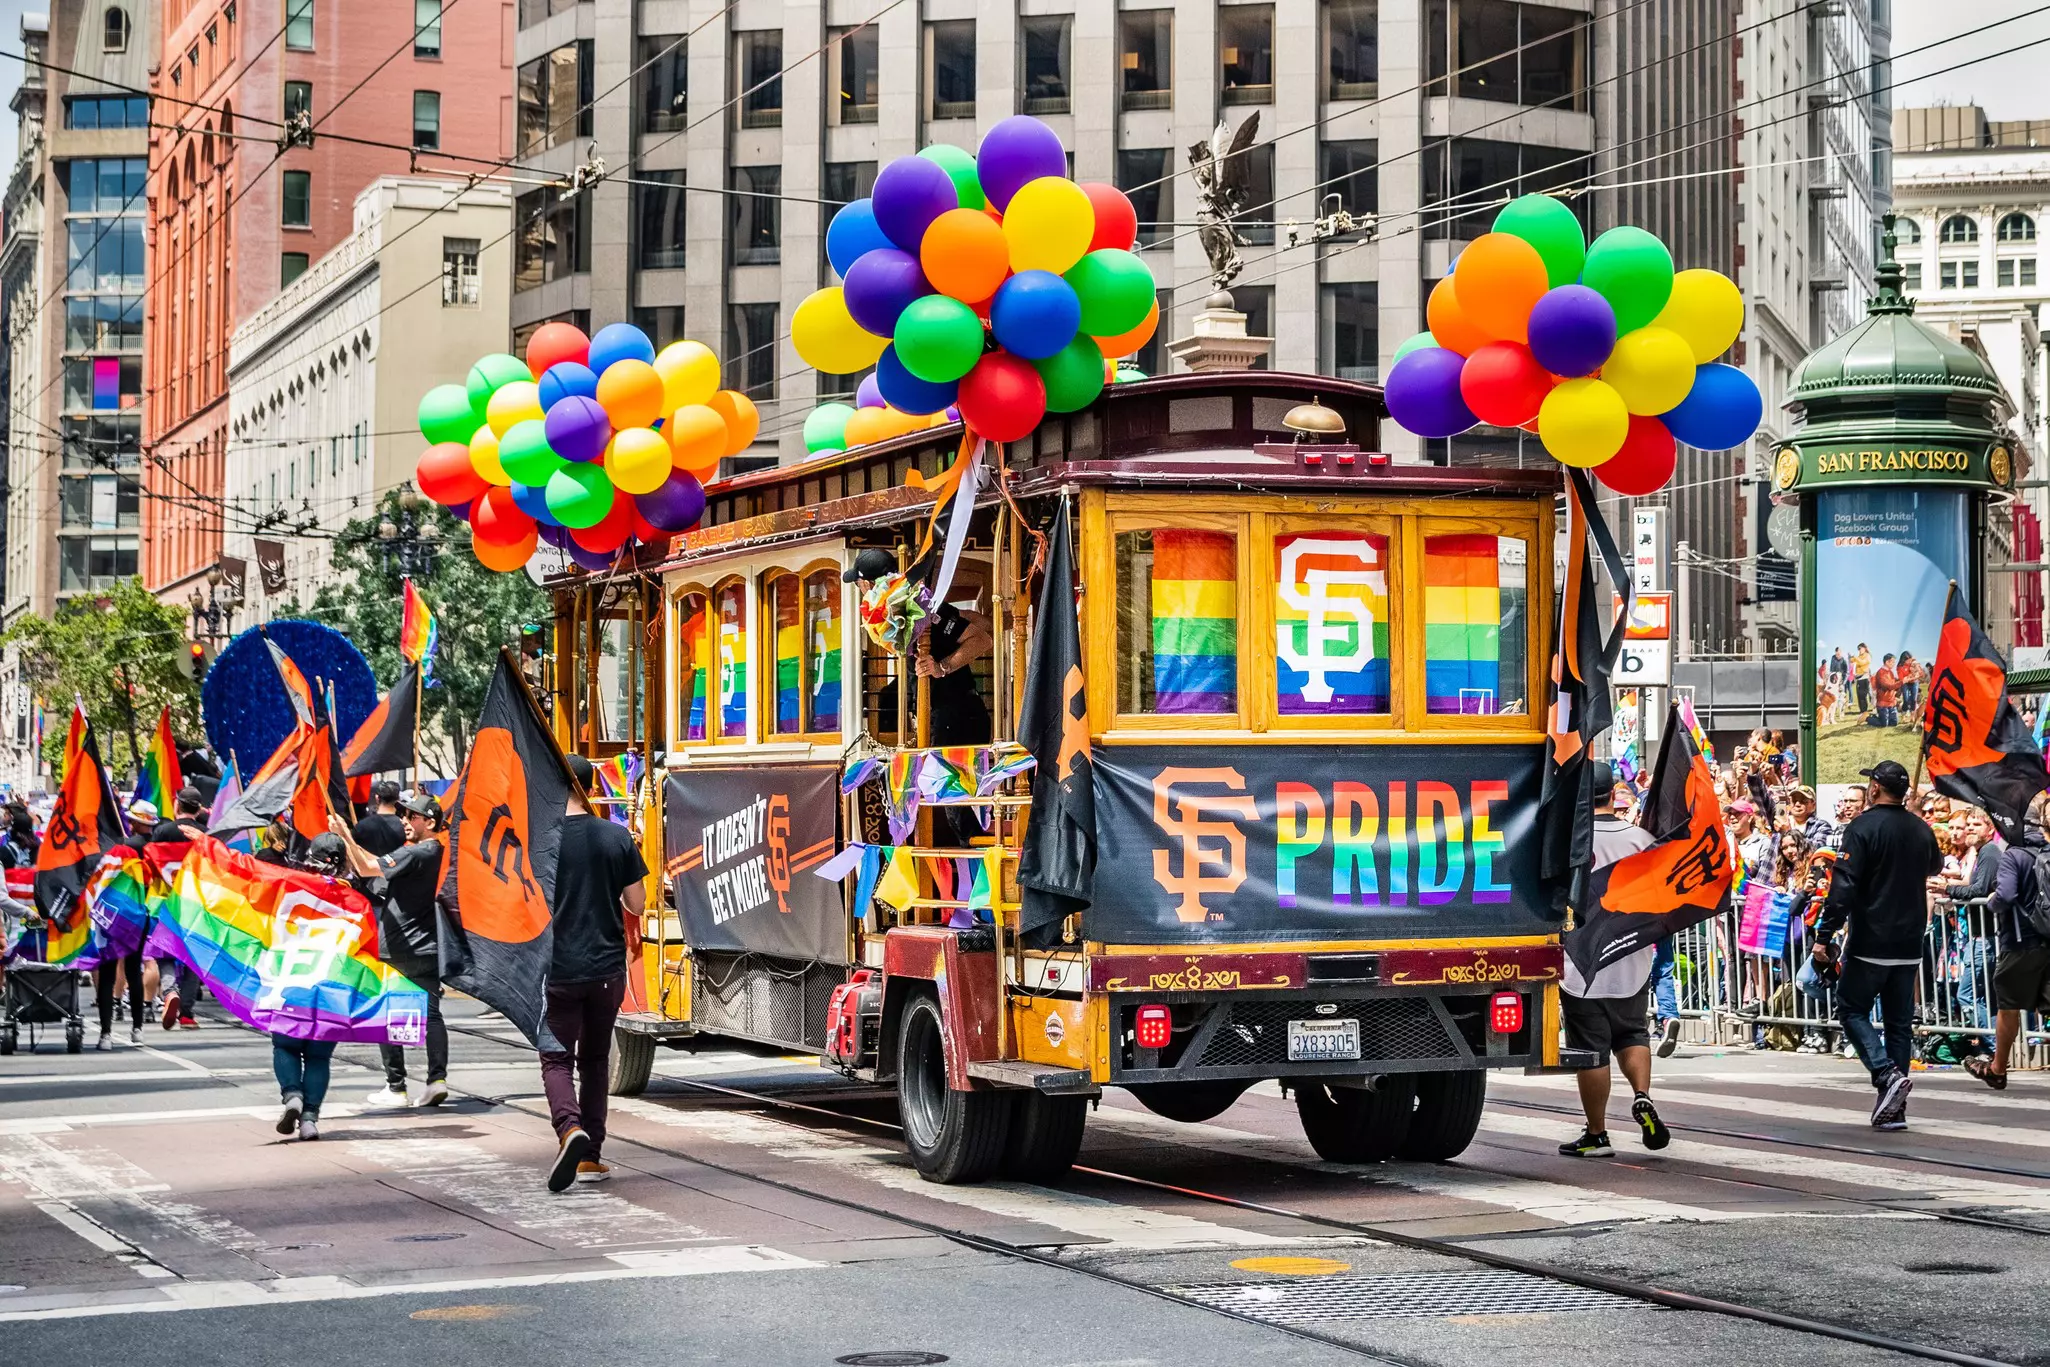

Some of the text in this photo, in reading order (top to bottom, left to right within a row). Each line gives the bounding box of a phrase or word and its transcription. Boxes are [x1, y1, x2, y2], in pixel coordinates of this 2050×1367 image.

[1818, 450, 1969, 474] SAN FRANCISCO
[1834, 512, 1915, 523] Dog Lovers Unite!
[1834, 523, 1909, 533] Facebook Group
[702, 794, 767, 870] IT DOESN'T
[1276, 780, 1512, 908] PRIDE
[707, 854, 770, 925] GET MORE
[1293, 1034, 1355, 1053] 3X83305
